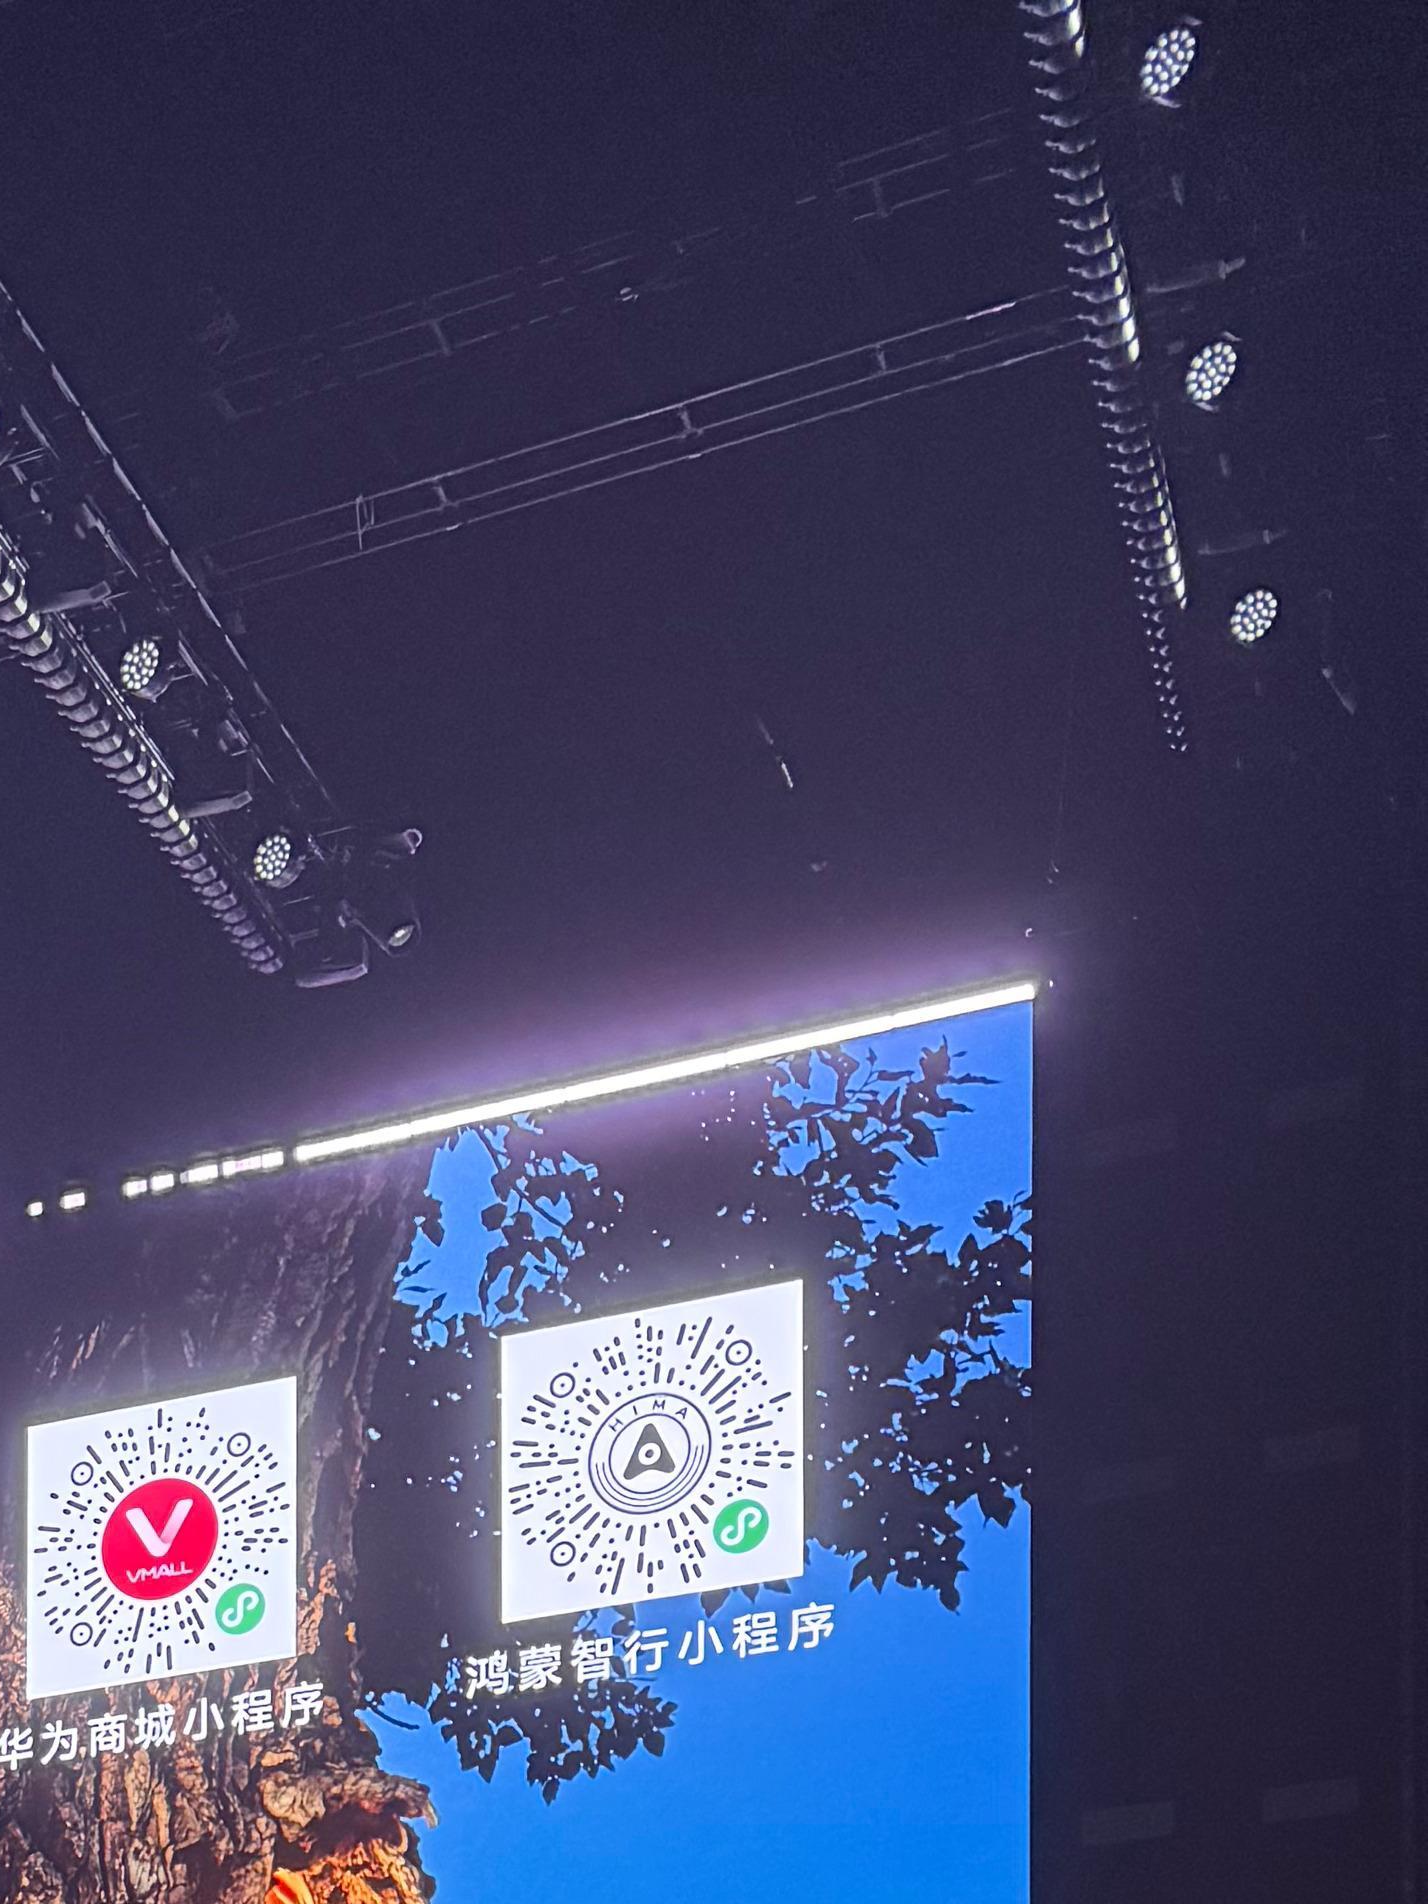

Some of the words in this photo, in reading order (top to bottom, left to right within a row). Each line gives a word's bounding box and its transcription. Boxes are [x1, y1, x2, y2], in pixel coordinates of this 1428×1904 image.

[608, 1399, 688, 1432] HIMA
[126, 1561, 194, 1583] VMALL
[464, 1601, 836, 1700] 鸿蒙智行小程序
